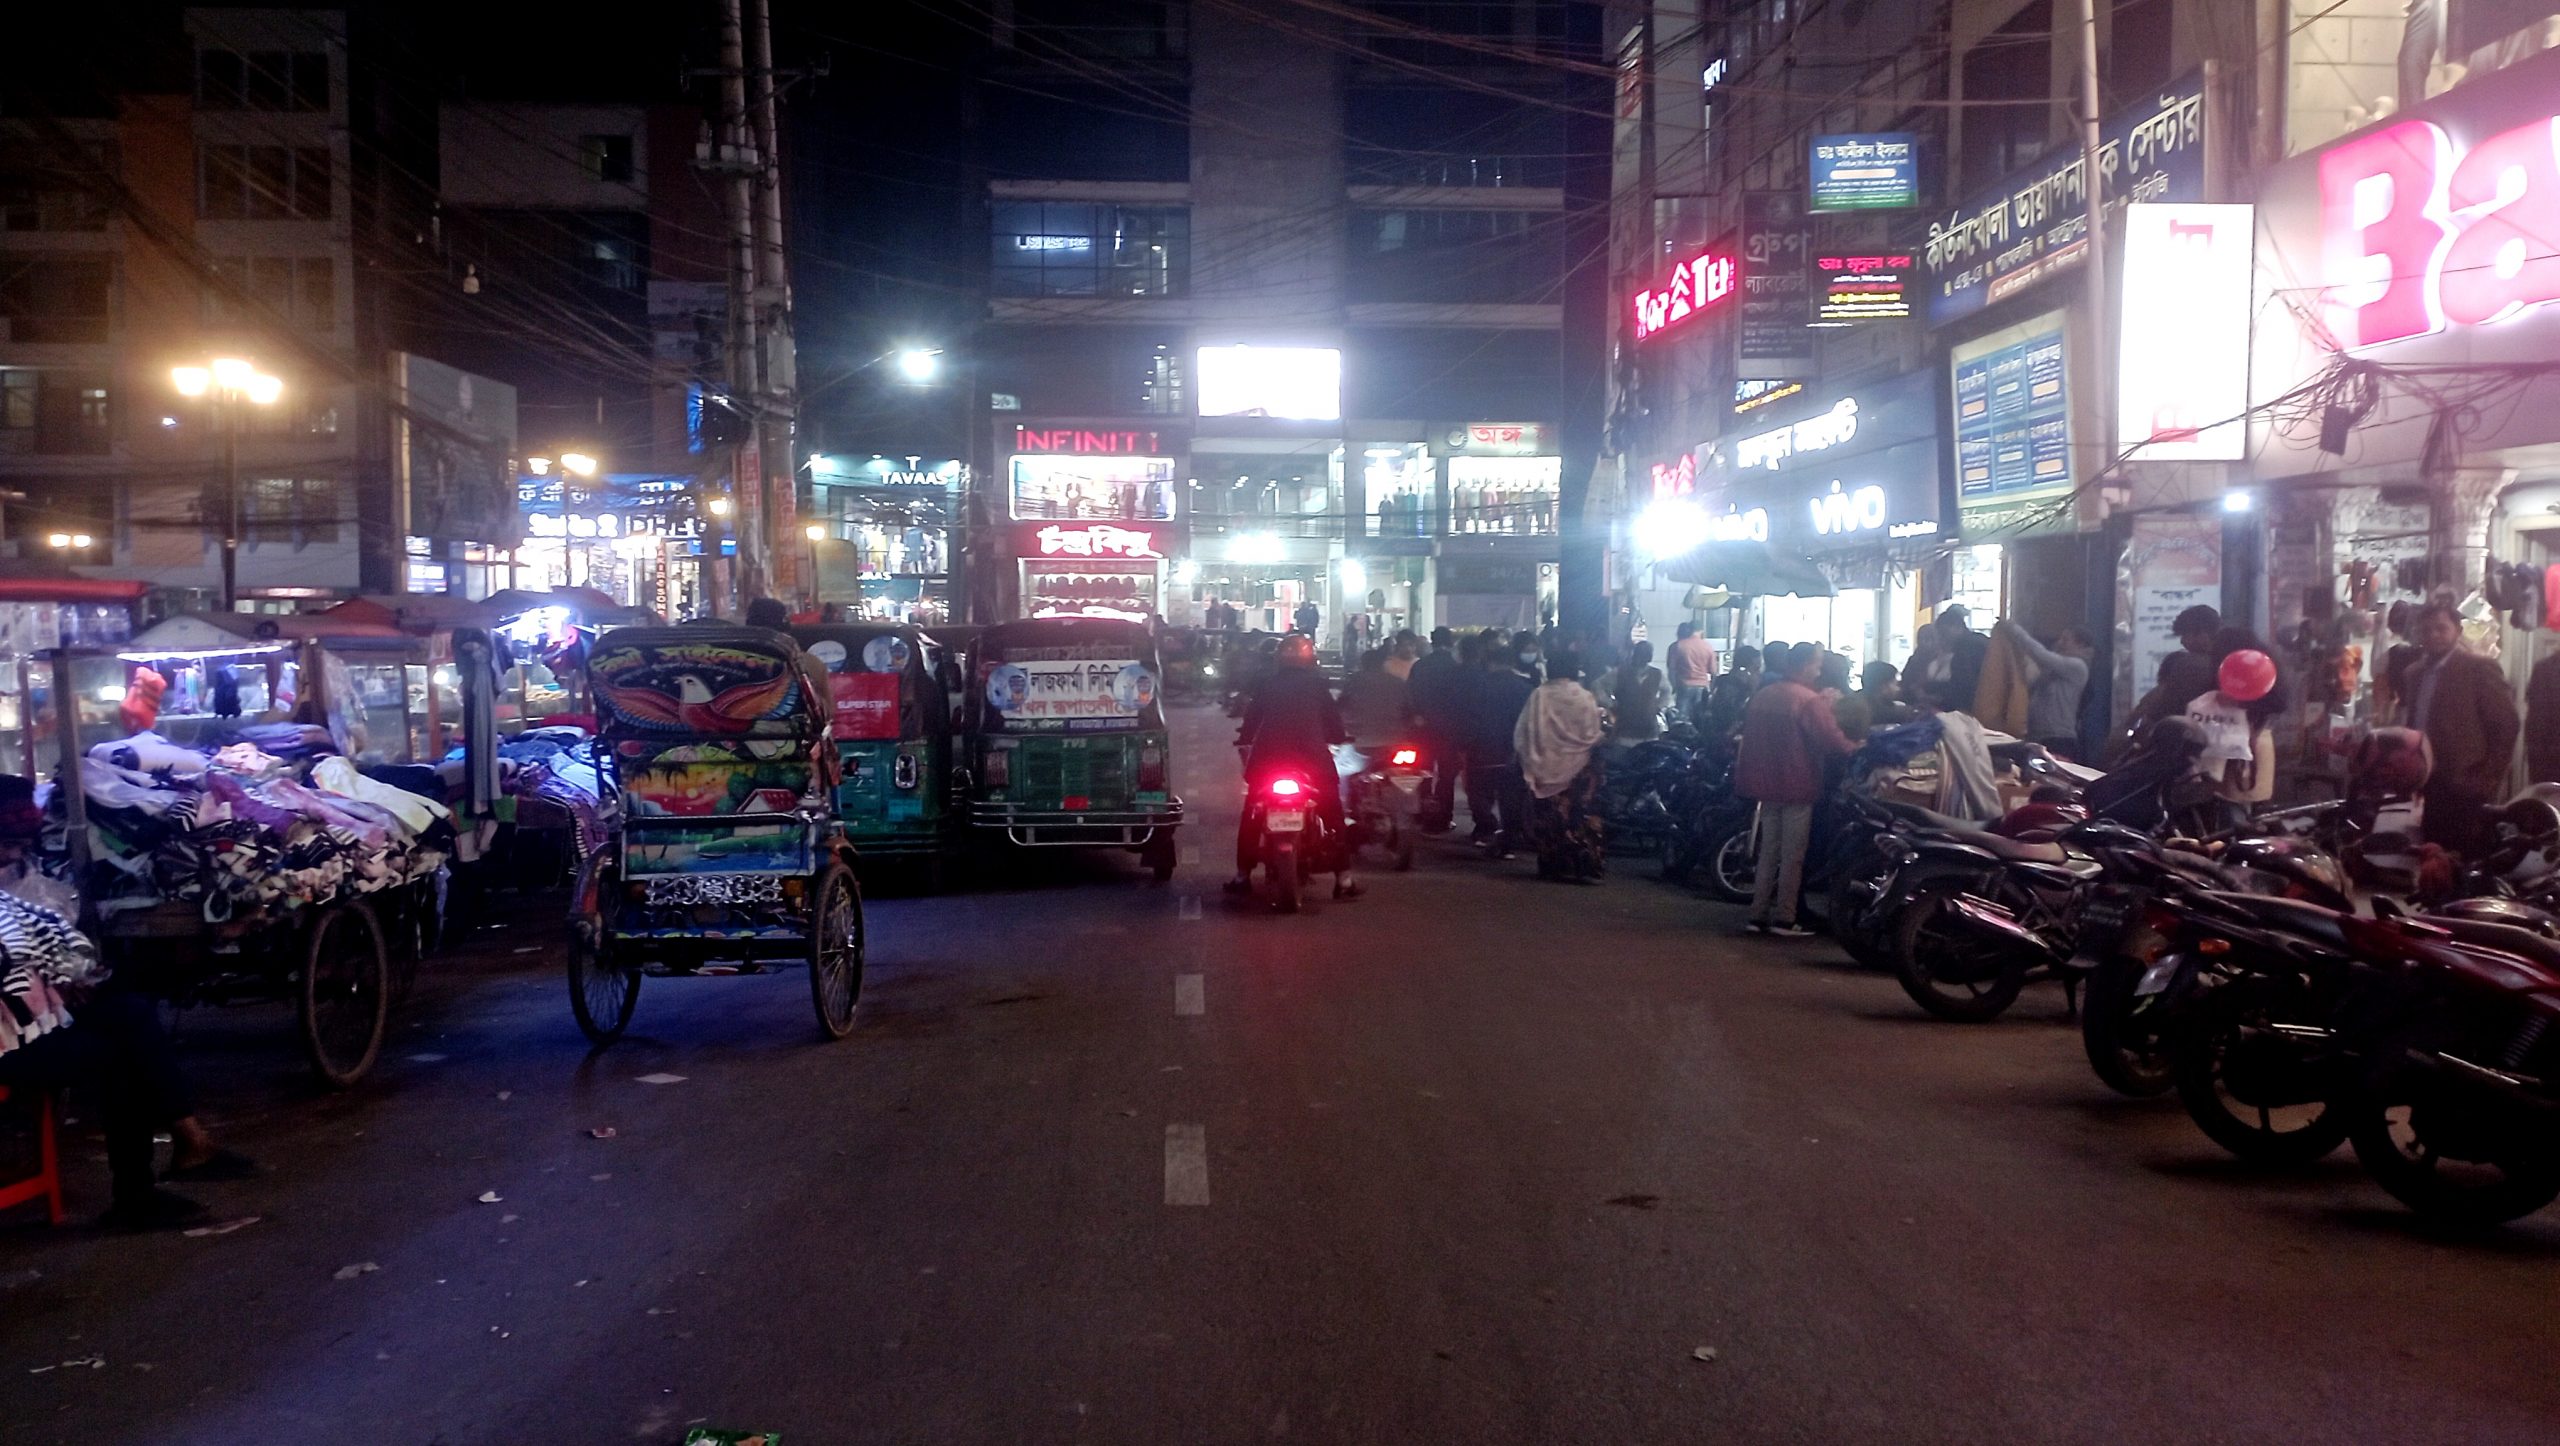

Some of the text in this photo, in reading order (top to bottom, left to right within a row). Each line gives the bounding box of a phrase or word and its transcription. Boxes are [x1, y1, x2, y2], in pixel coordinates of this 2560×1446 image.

[2128, 93, 2202, 174] সেন্টার
[881, 472, 949, 485] TAVAAS
[1810, 479, 1886, 535] vivo
[1087, 664, 1124, 693] লিমি
